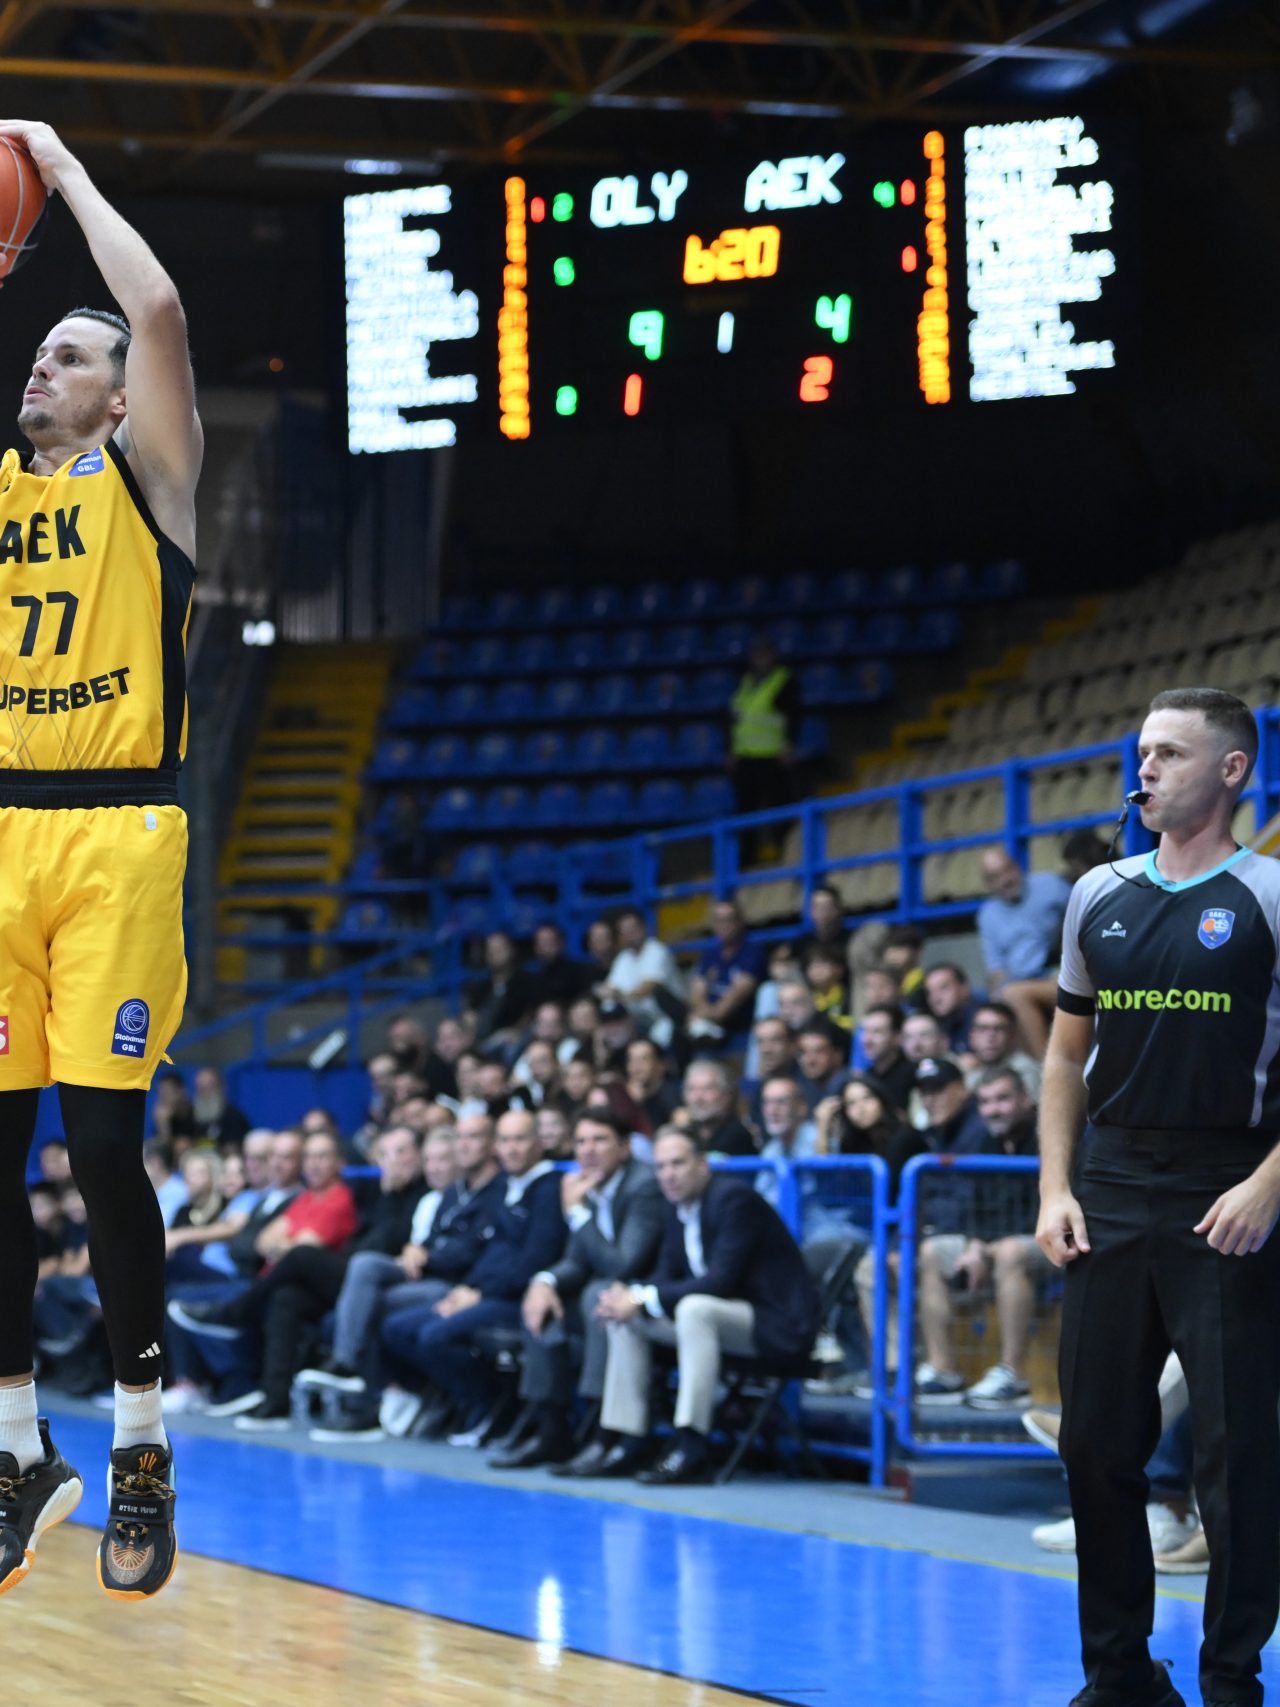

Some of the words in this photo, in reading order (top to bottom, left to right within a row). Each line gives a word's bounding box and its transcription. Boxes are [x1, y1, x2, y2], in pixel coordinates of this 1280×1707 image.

[590, 170, 688, 228] OLY
[744, 152, 846, 213] AEK
[628, 310, 664, 361] 9
[815, 293, 851, 343] 4
[799, 355, 833, 402] 2
[11, 591, 79, 657] 77
[122, 1044, 138, 1053] GBL
